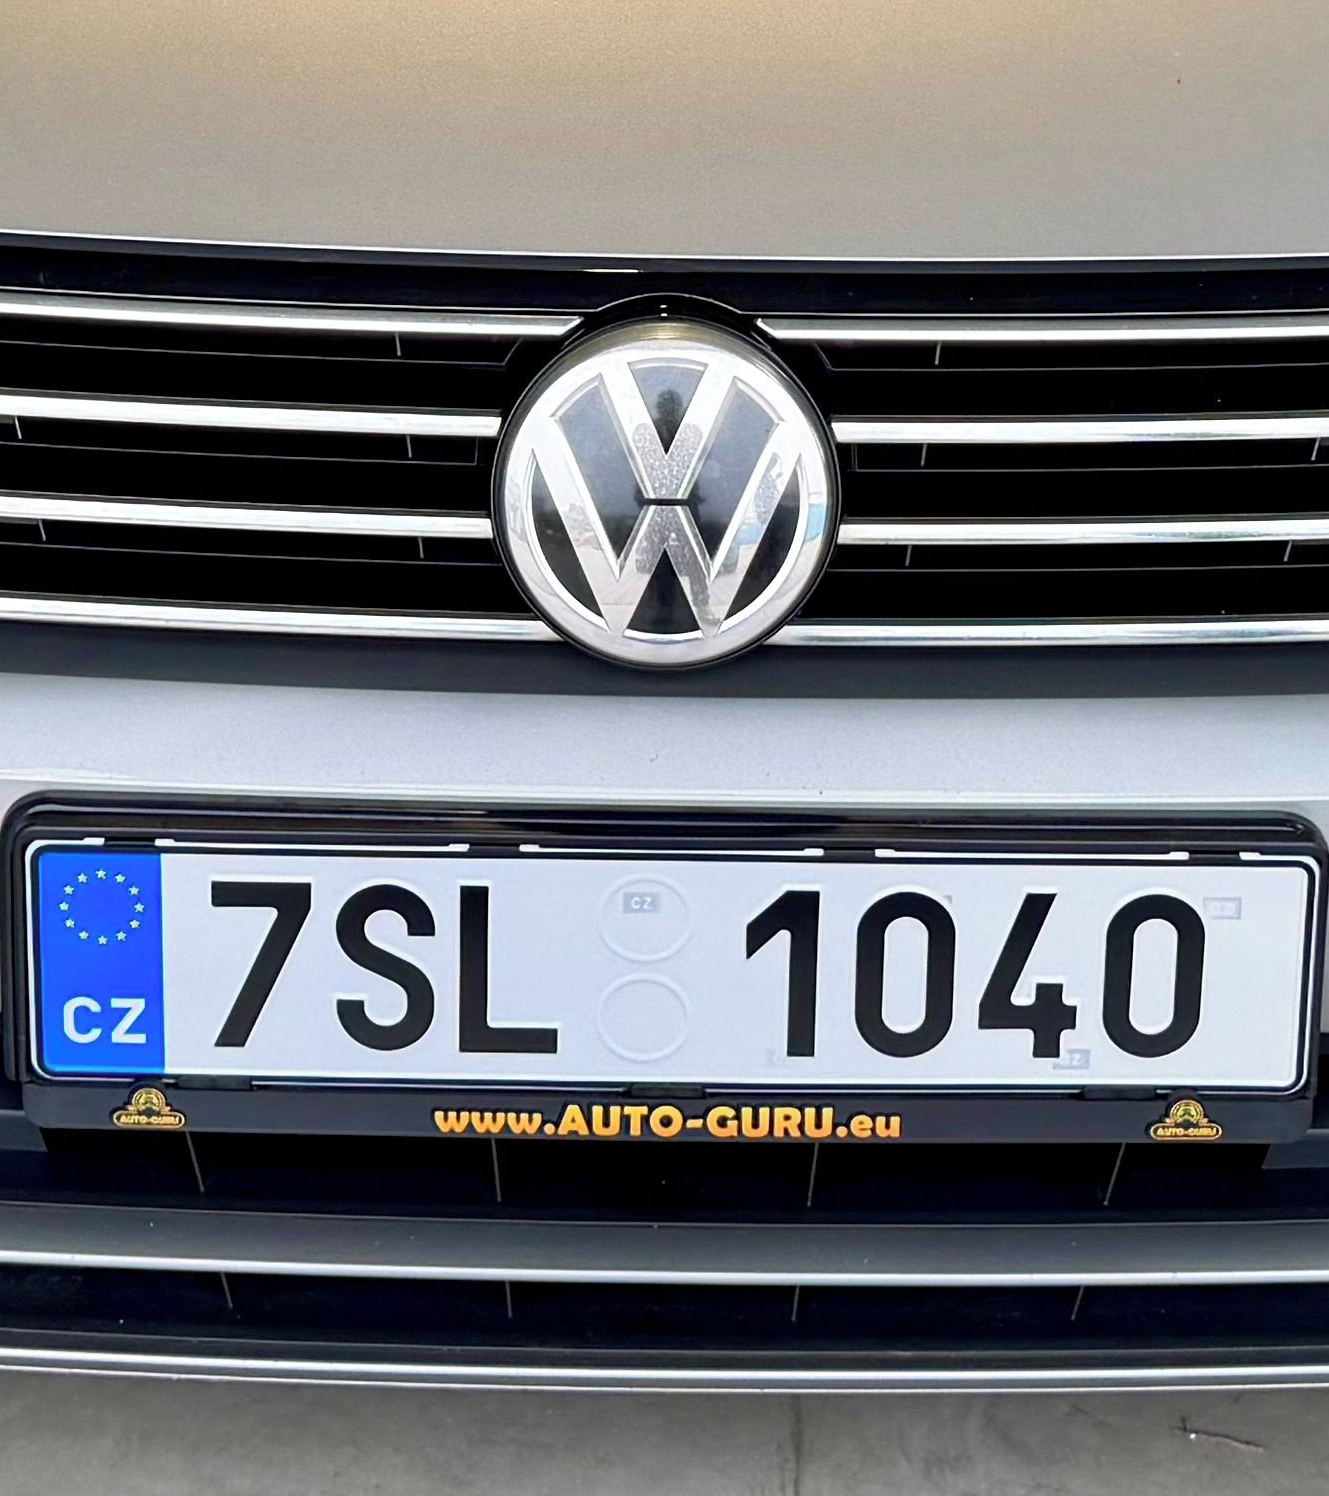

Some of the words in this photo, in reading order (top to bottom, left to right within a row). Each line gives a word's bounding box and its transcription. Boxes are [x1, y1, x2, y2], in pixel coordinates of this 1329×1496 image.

[630, 896, 653, 910] CZ
[210, 880, 559, 1054] 7SL
[746, 888, 1206, 1059] 1040
[63, 996, 147, 1044] CZ
[433, 1103, 902, 1139] www.AUTO-GURU.eu
